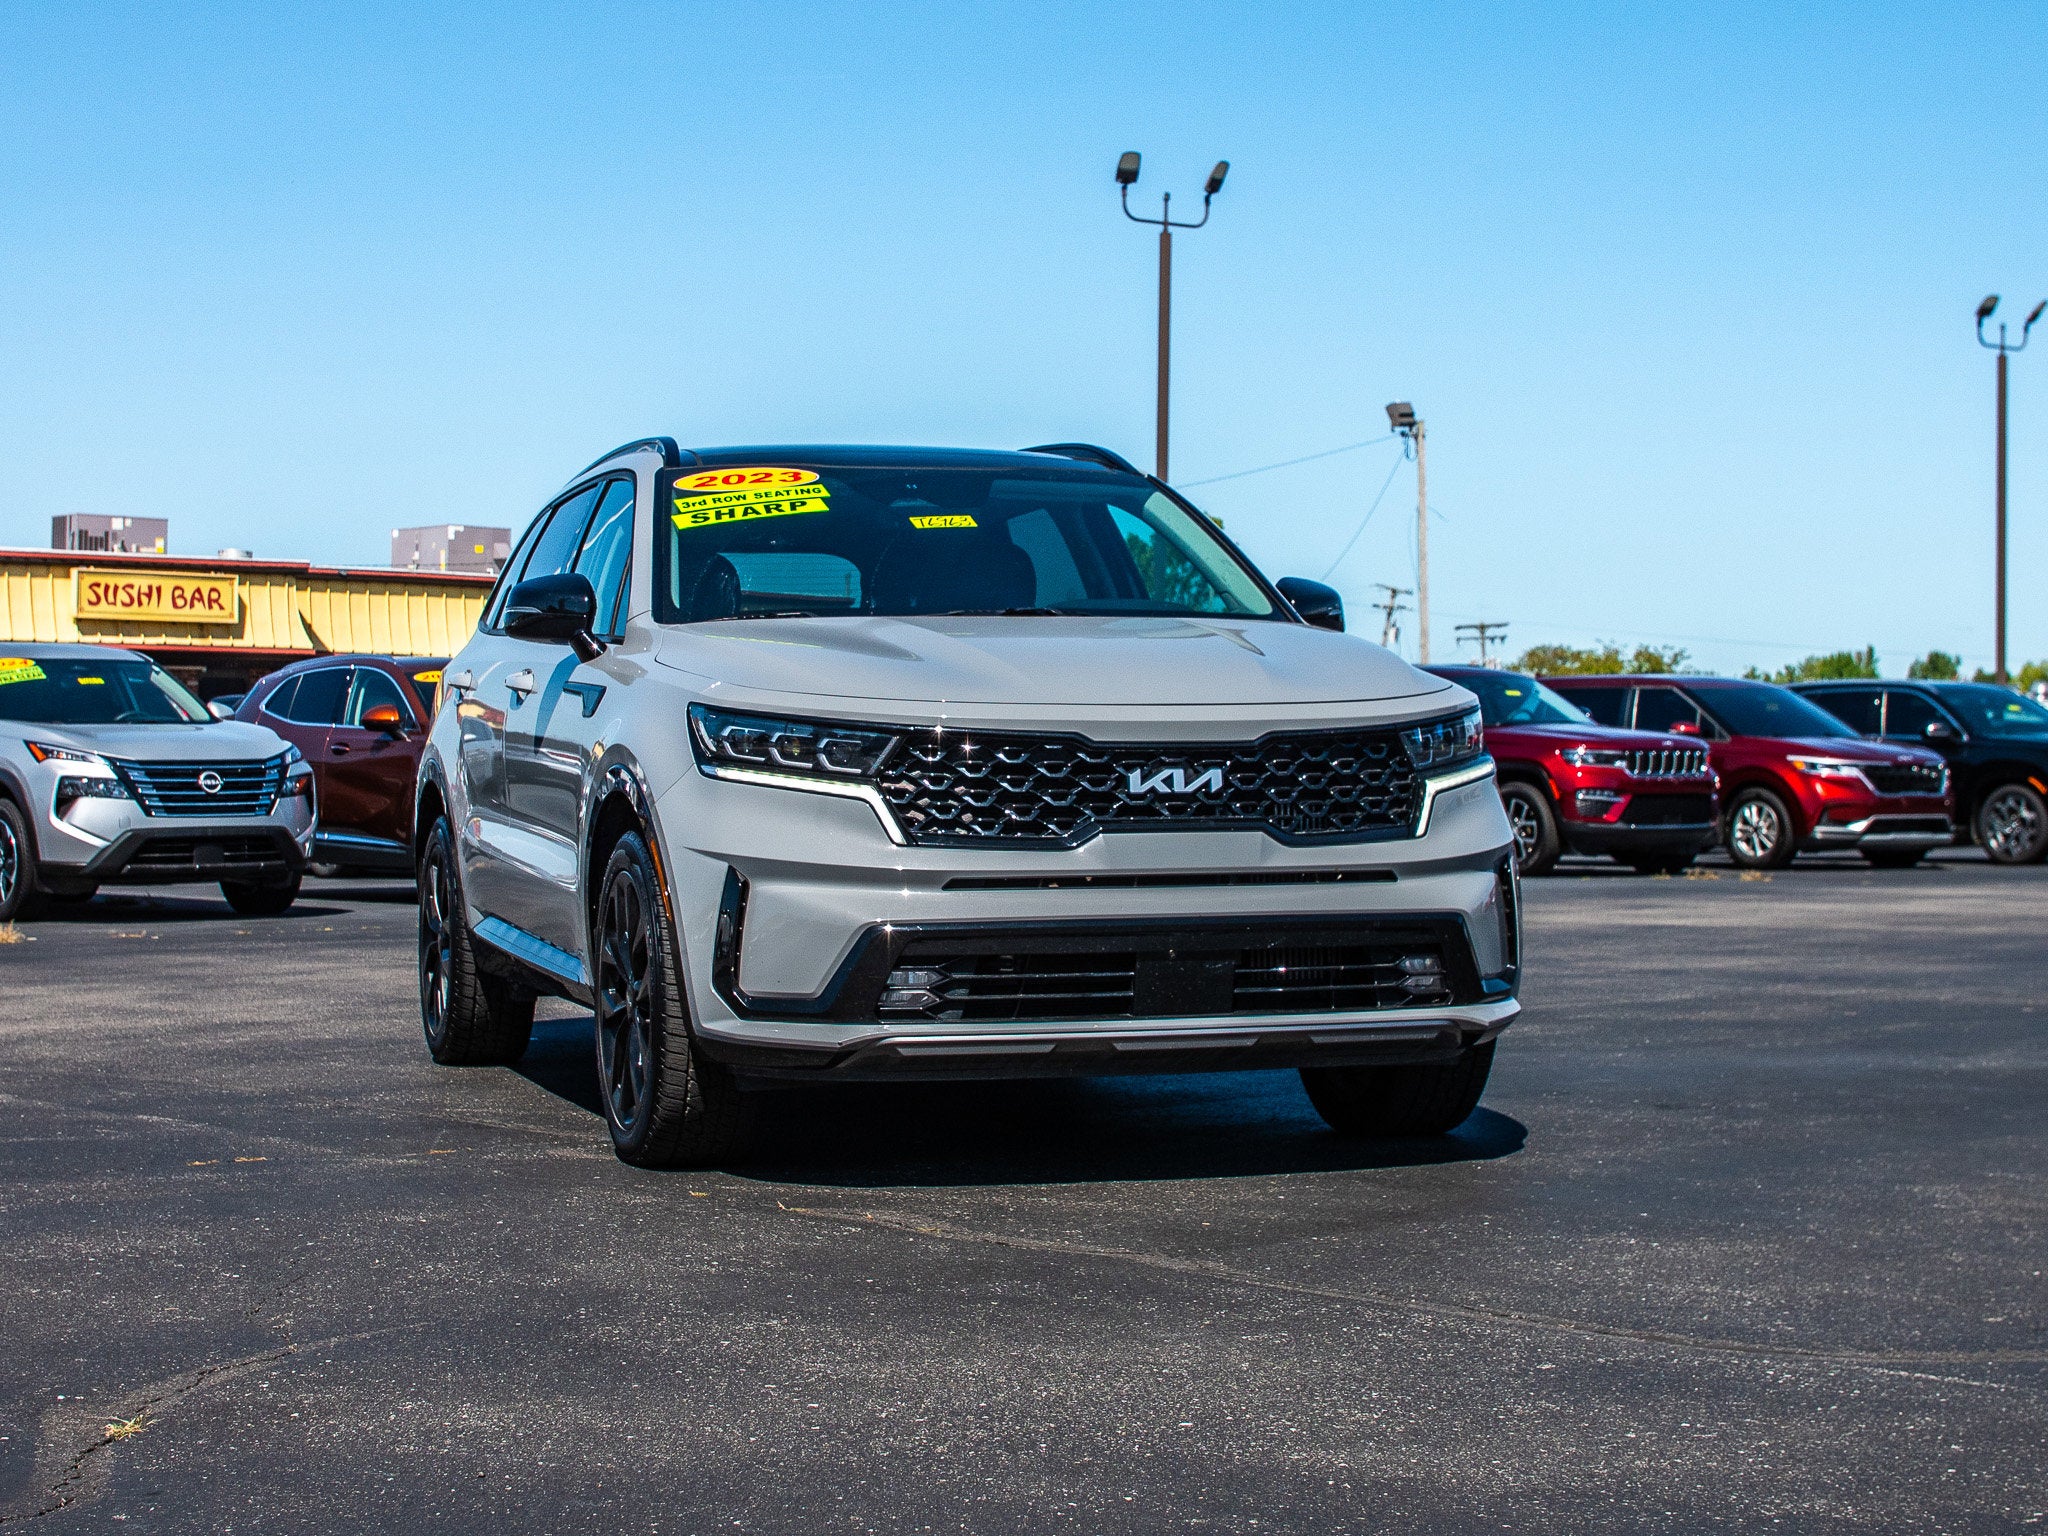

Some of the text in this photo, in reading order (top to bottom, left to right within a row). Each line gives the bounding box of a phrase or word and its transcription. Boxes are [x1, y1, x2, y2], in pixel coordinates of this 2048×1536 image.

[693, 472, 802, 488] 2023
[682, 487, 822, 509] 3rd ROW SEATING
[691, 500, 808, 524] SHARP
[87, 582, 225, 611] SUSHI BAR
[1129, 768, 1223, 793] KIA
